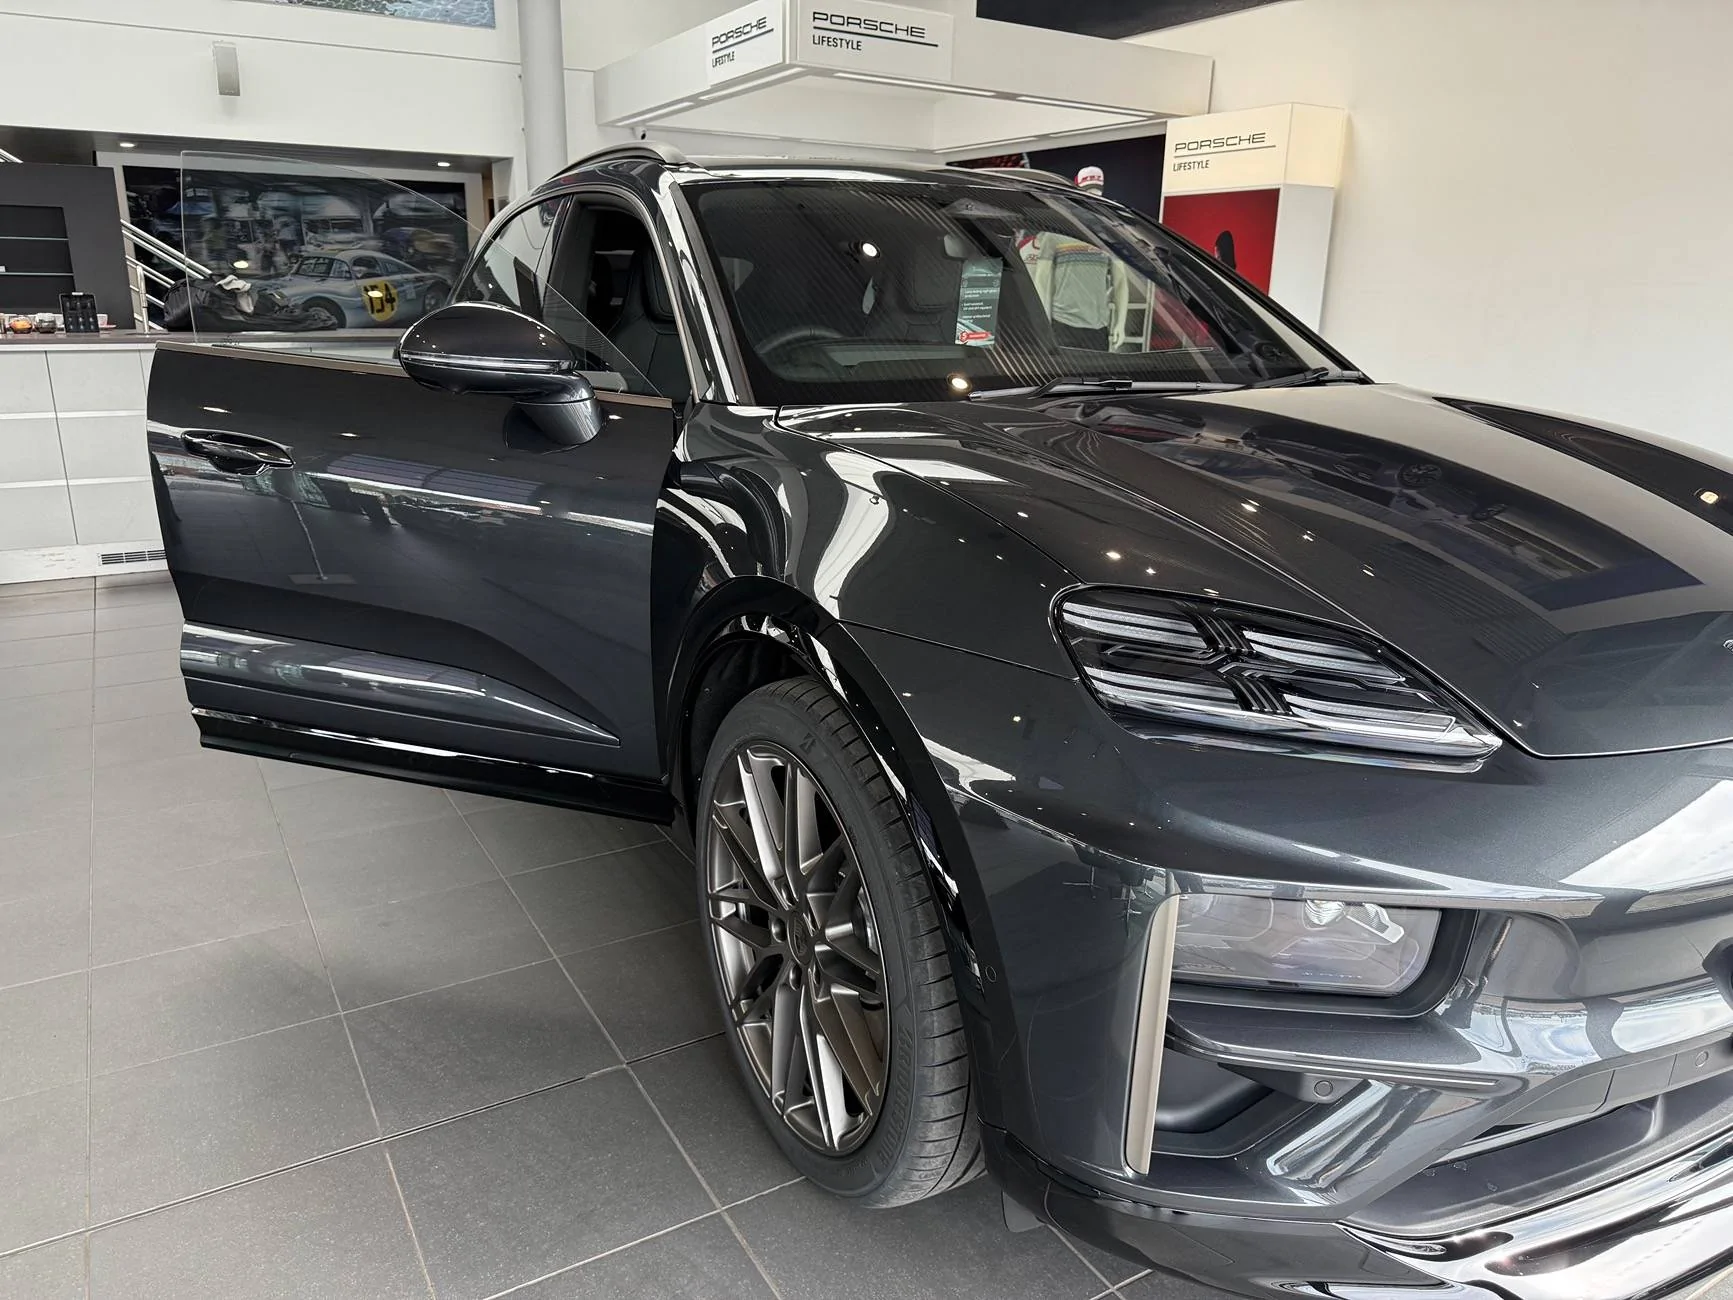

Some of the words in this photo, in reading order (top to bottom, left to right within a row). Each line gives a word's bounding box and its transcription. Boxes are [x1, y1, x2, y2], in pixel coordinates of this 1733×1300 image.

[711, 16, 768, 48] PORSCHE
[811, 11, 927, 39] PORSCHE
[811, 34, 863, 52] LIFESTYLE
[711, 51, 736, 68] LIFESTYLE
[1174, 132, 1267, 153] PORSCHE
[1172, 159, 1211, 173] LIFESTYLE
